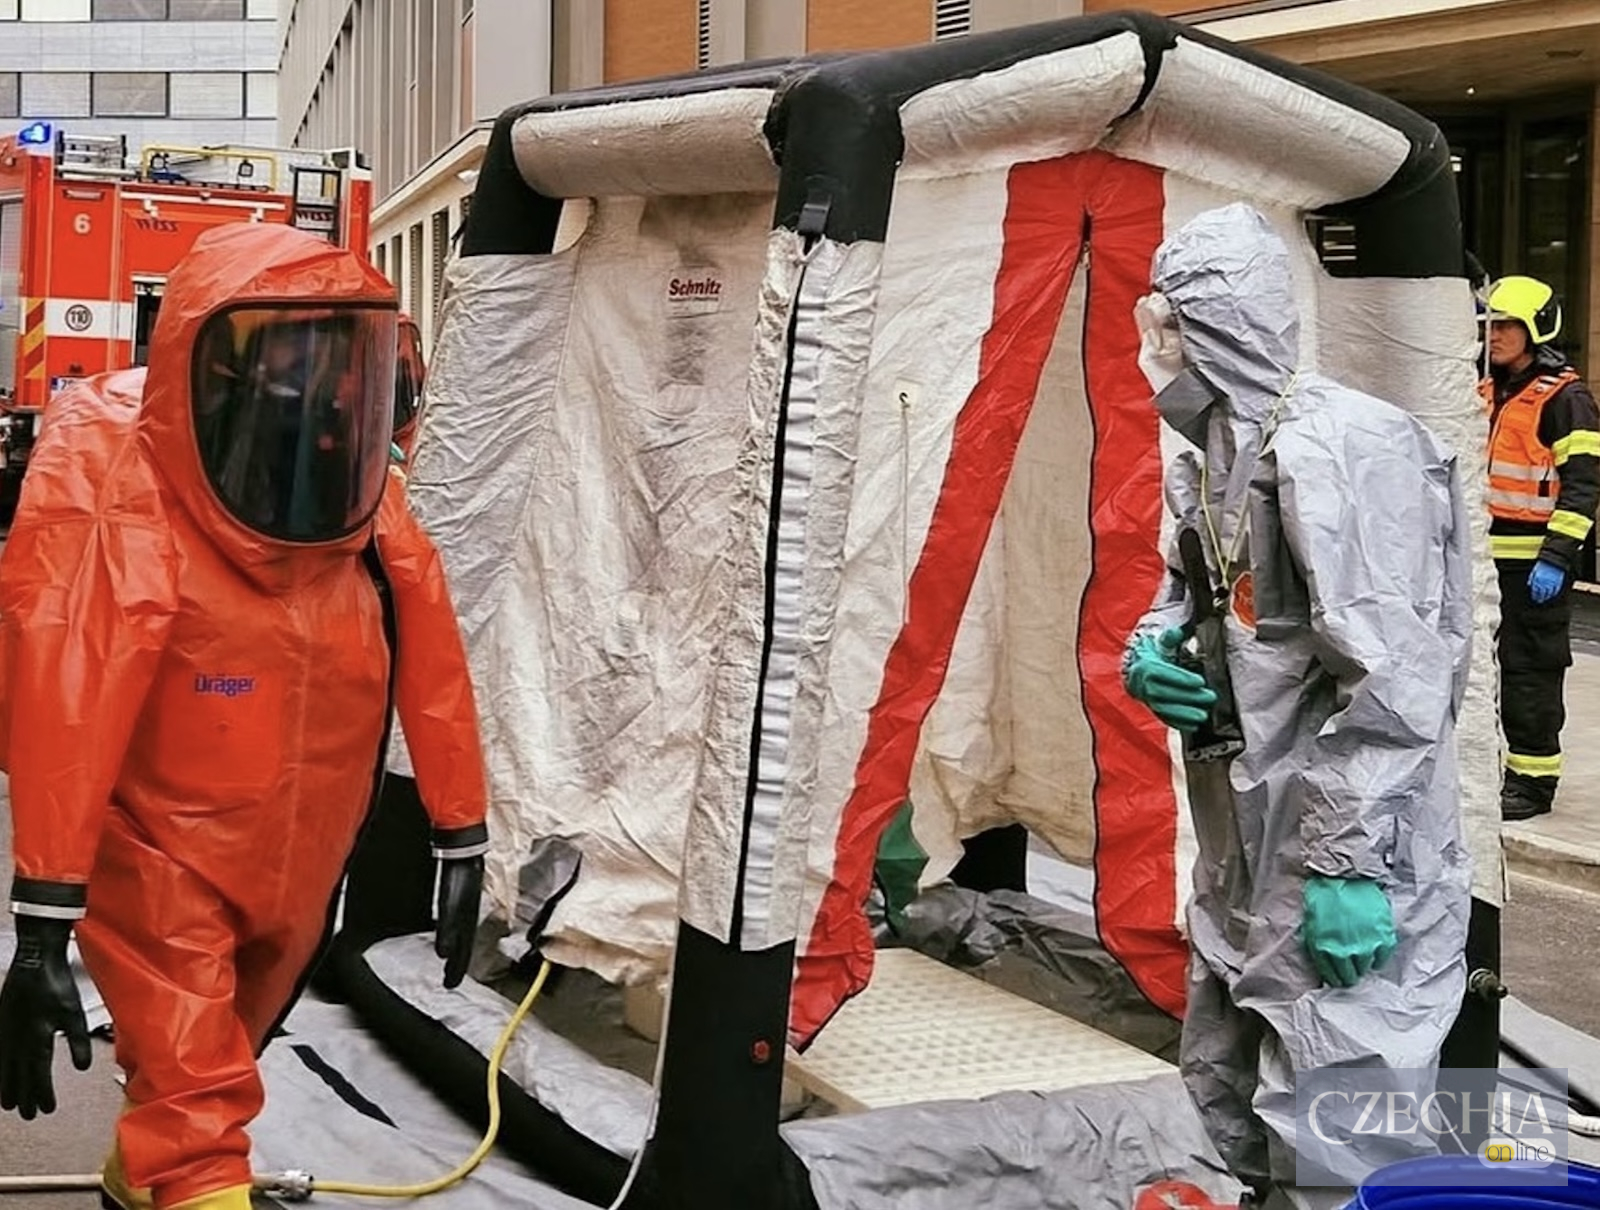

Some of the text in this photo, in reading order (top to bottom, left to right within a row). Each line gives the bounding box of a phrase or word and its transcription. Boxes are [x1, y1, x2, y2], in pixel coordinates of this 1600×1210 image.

[74, 213, 91, 234] 6
[669, 278, 721, 296] Schnitz
[70, 310, 88, 324] 110
